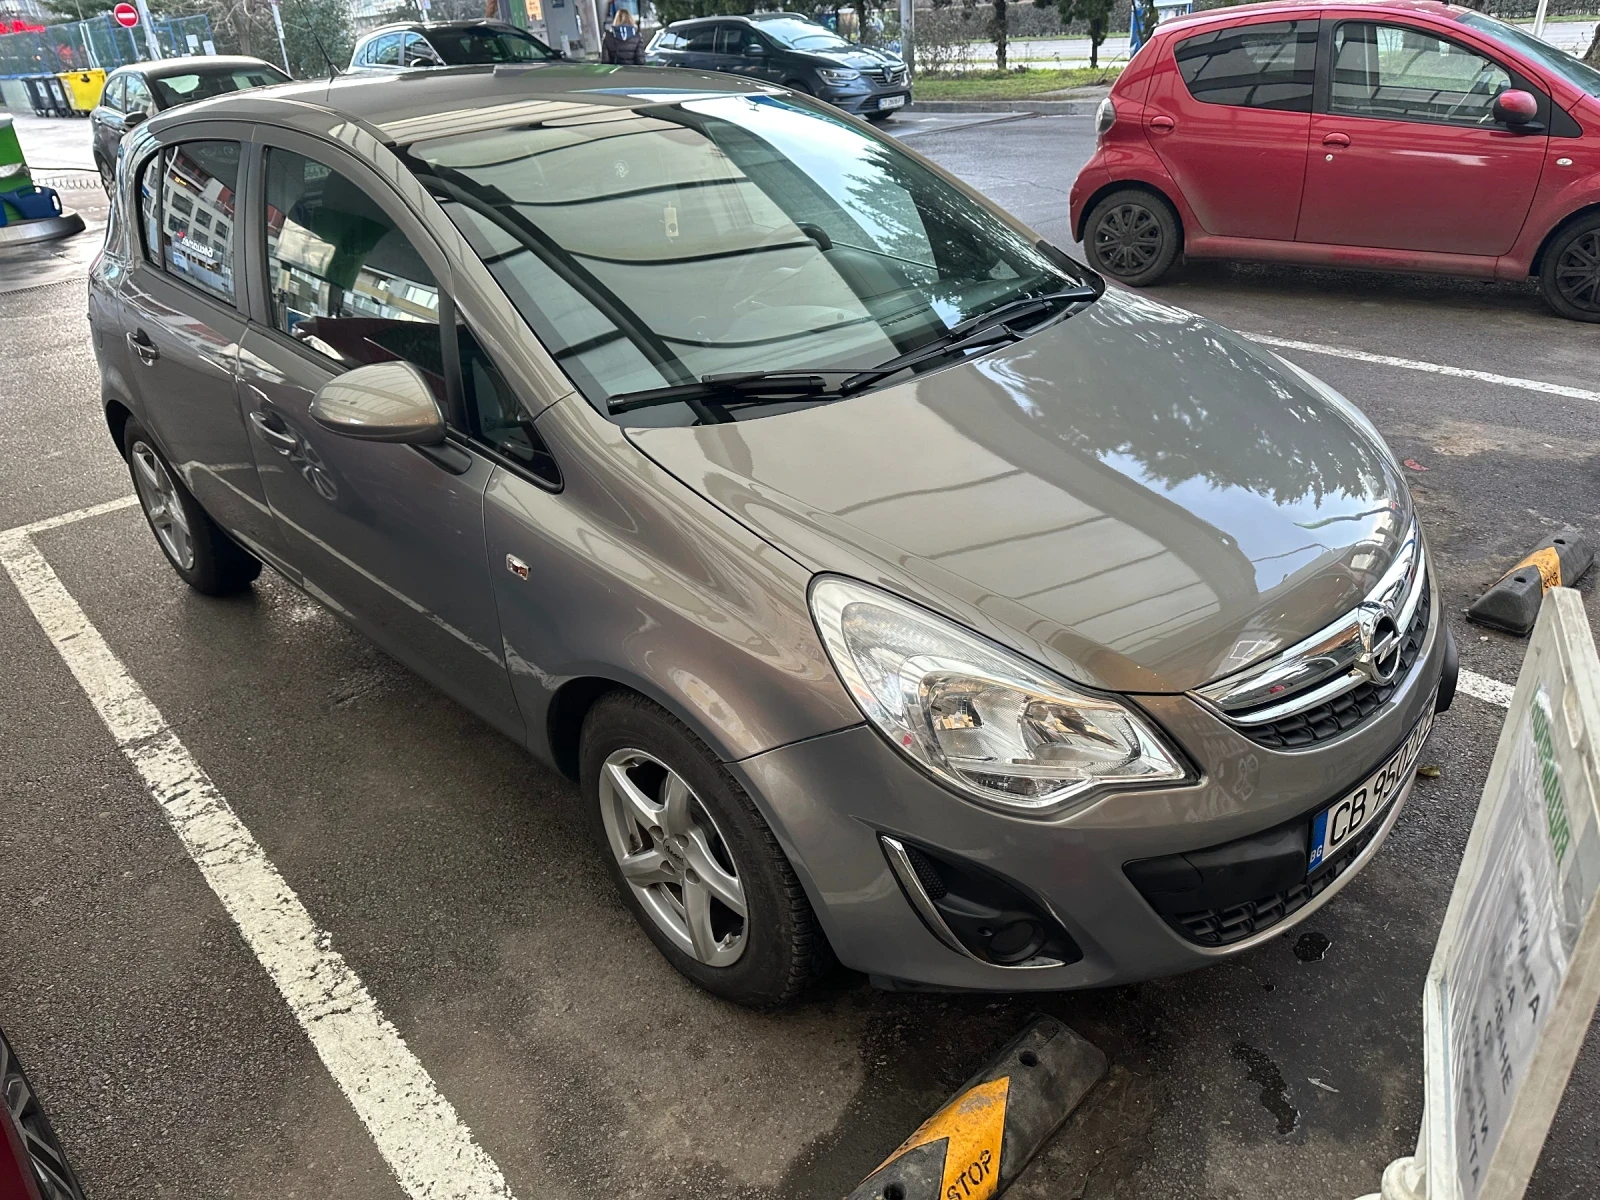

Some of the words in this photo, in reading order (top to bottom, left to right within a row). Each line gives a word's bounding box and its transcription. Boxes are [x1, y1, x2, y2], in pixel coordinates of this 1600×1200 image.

[1330, 787, 1368, 847] CB
[1309, 845, 1323, 863] BG
[947, 1150, 991, 1200] STOP
